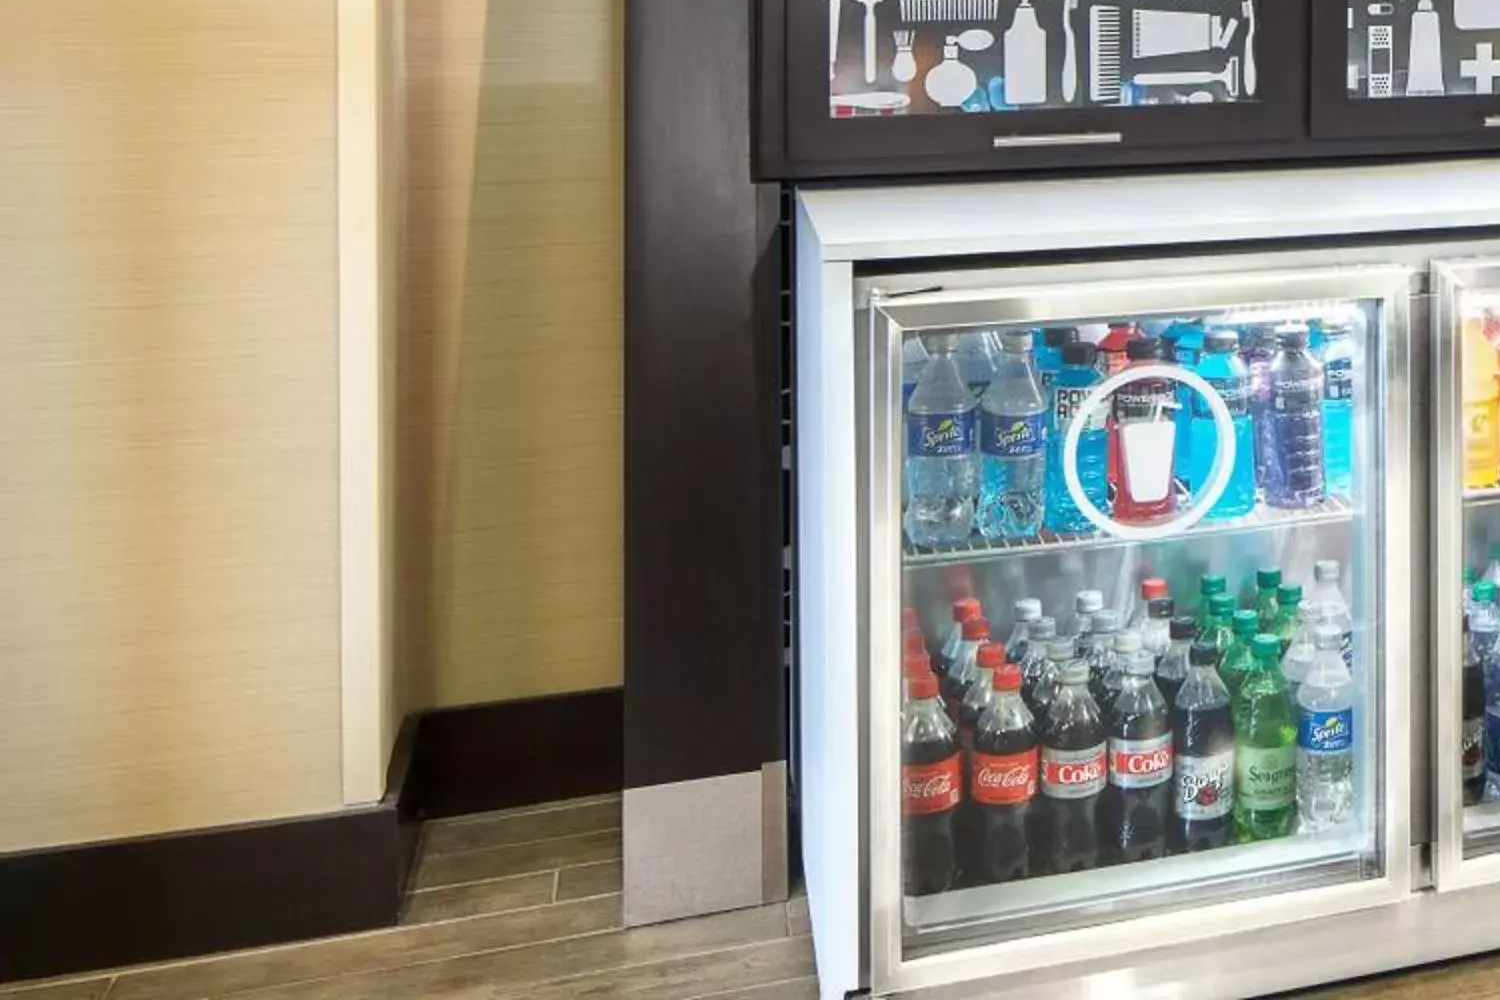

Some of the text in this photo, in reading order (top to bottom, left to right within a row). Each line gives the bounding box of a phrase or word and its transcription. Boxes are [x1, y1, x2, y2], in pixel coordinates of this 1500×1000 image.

[924, 426, 961, 447] Sprite
[1312, 722, 1345, 743] Sprite
[1059, 761, 1101, 784] Coke
[1128, 749, 1169, 773] Coke
[978, 763, 1031, 788] Coca-Cola
